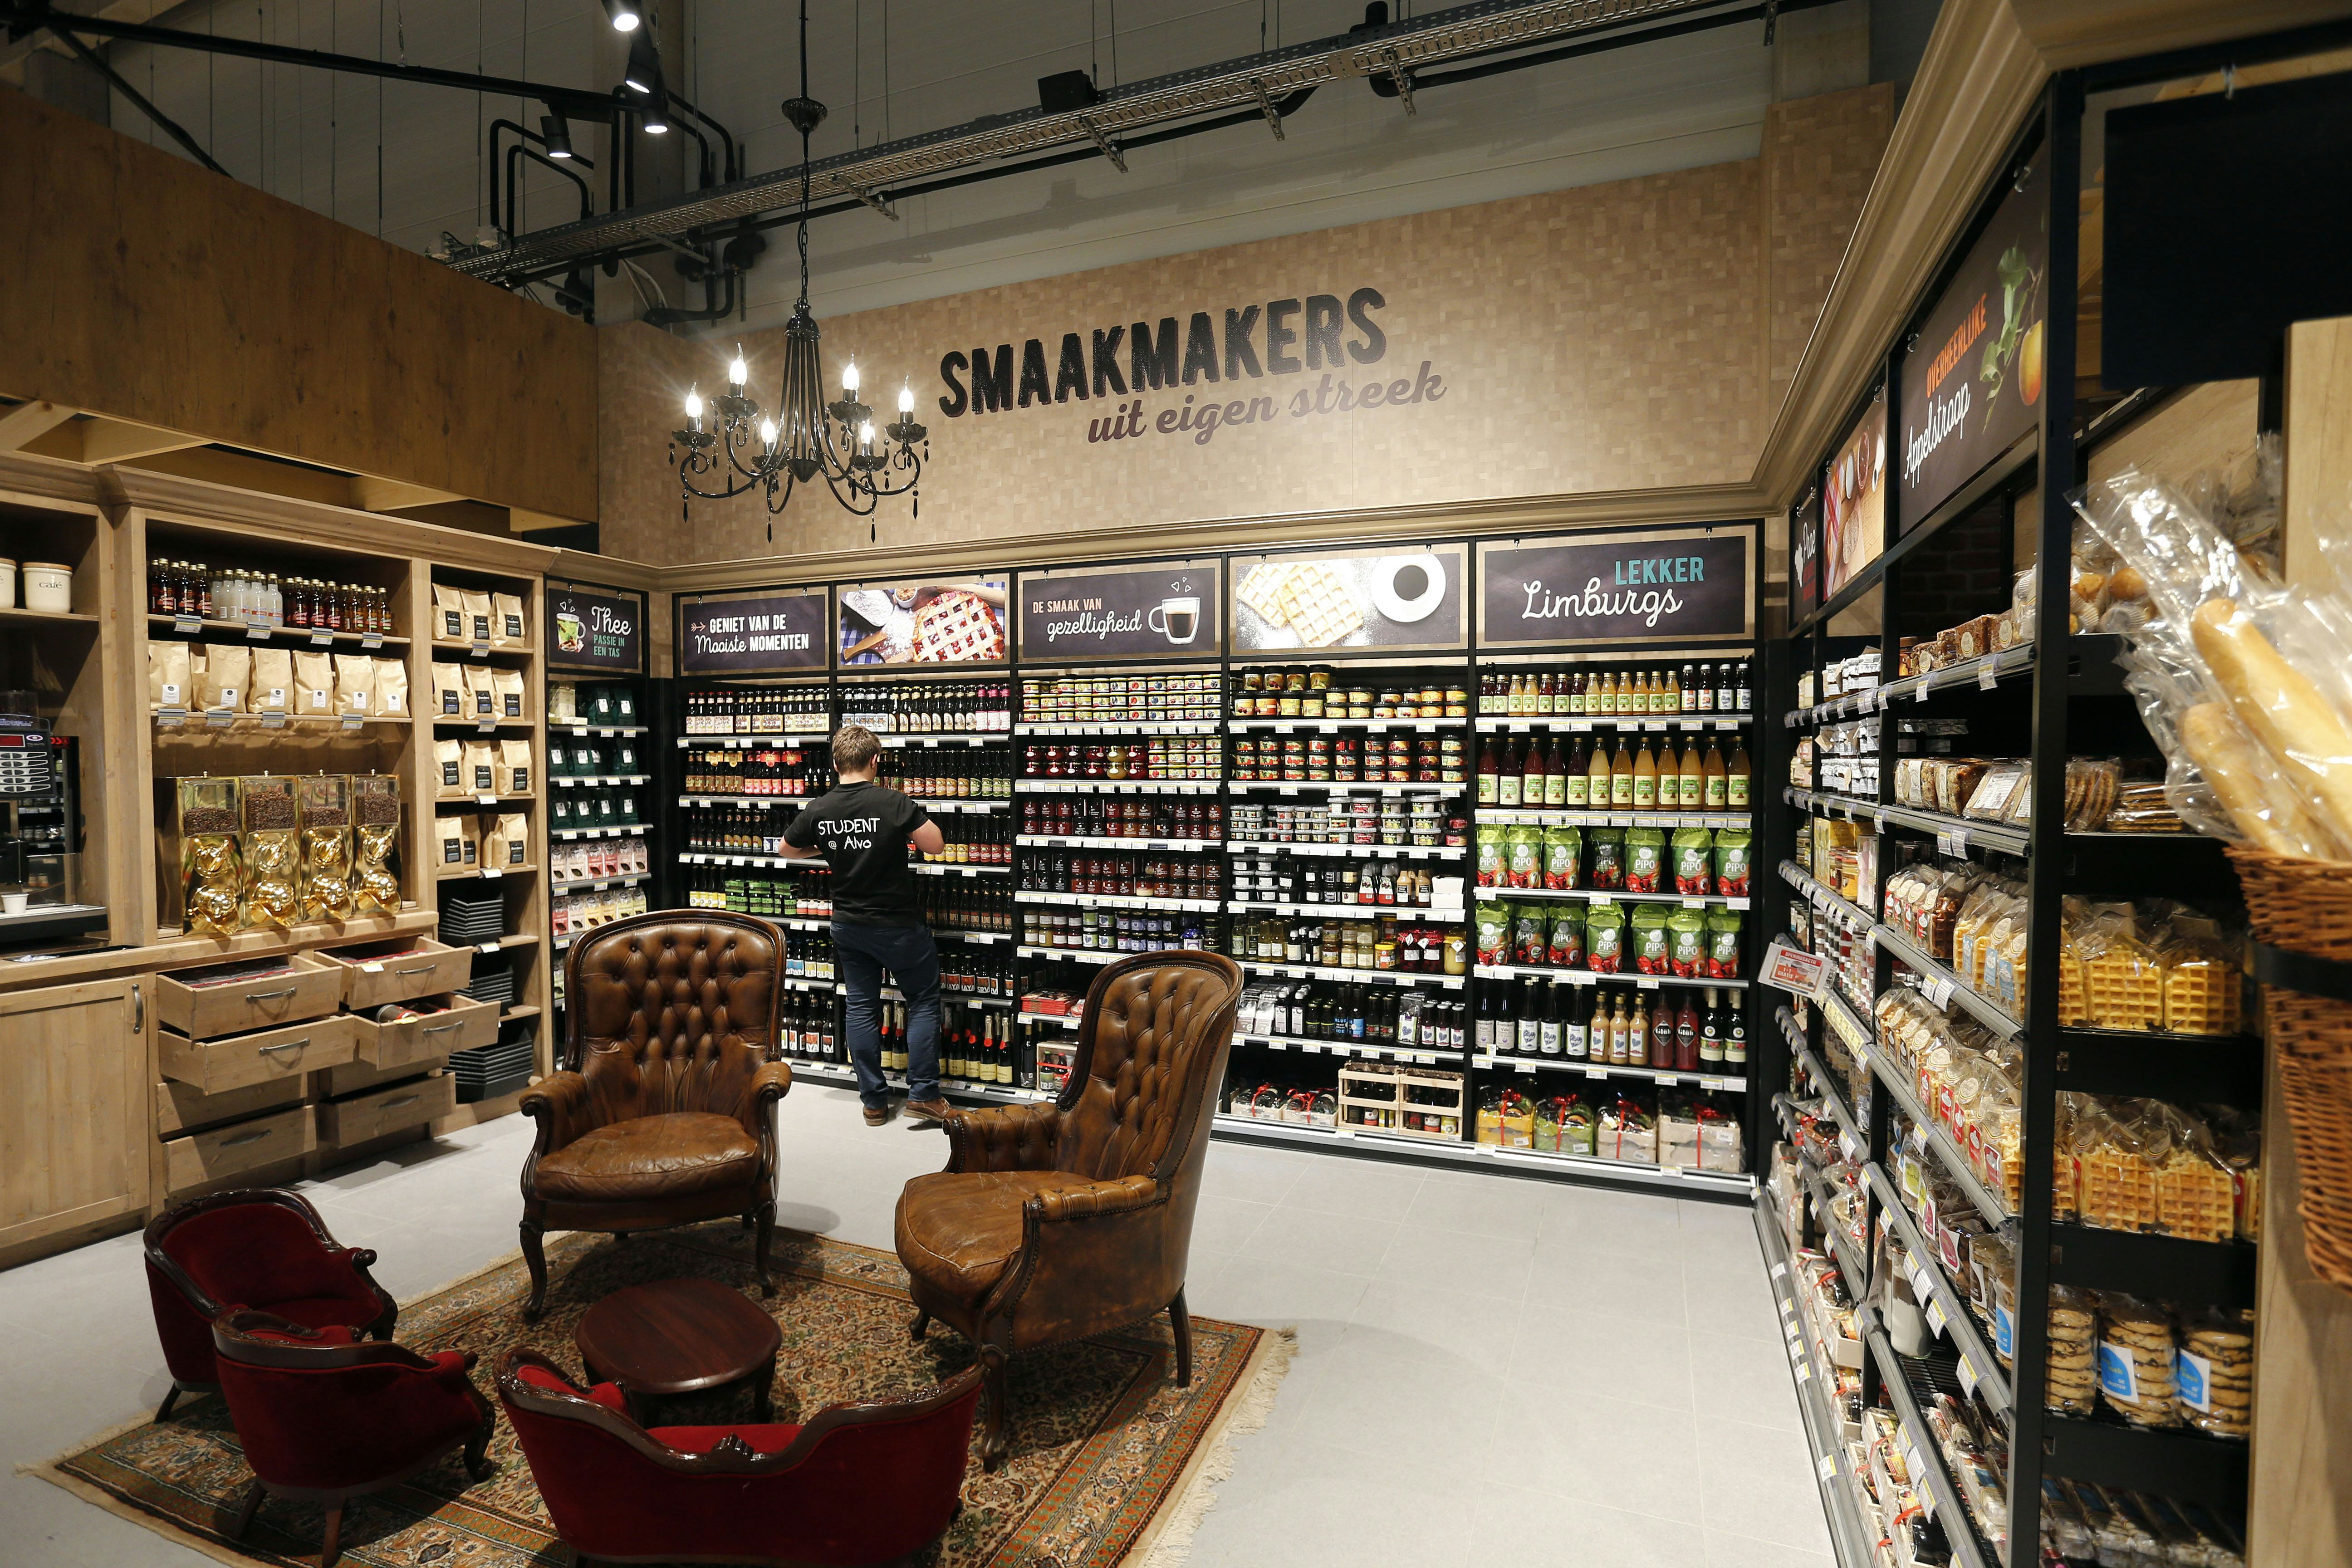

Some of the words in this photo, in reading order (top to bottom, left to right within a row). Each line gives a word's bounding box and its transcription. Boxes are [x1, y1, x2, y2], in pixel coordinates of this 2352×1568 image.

[938, 288, 1386, 418] SMAAKMAKERS
[1926, 292, 1986, 398] OVERHEERLIJKE
[1088, 397, 1147, 443] uit
[1156, 394, 1279, 446] eigen
[1289, 361, 1447, 416] streek
[1905, 382, 1971, 488] Appelstroop
[1615, 557, 1704, 585] LEKKER
[1033, 601, 1044, 613] DE
[1047, 599, 1079, 613] SMAAK
[1083, 598, 1102, 611] VAN
[1522, 577, 1684, 627] Limburgs
[591, 606, 631, 635] Thee
[710, 617, 745, 633] GENIET
[748, 615, 769, 632] VAN
[773, 614, 786, 630] DE
[1047, 609, 1142, 642] gezelligheid
[594, 634, 616, 646] PASSIE
[618, 637, 625, 647] IN
[594, 646, 606, 656] EEN
[608, 648, 620, 657] TAS
[695, 635, 747, 654] Mooiste
[750, 633, 809, 652] MOMENTEN
[818, 818, 881, 836] STUDENT
[828, 840, 837, 850] @
[844, 835, 872, 850] Alvo
